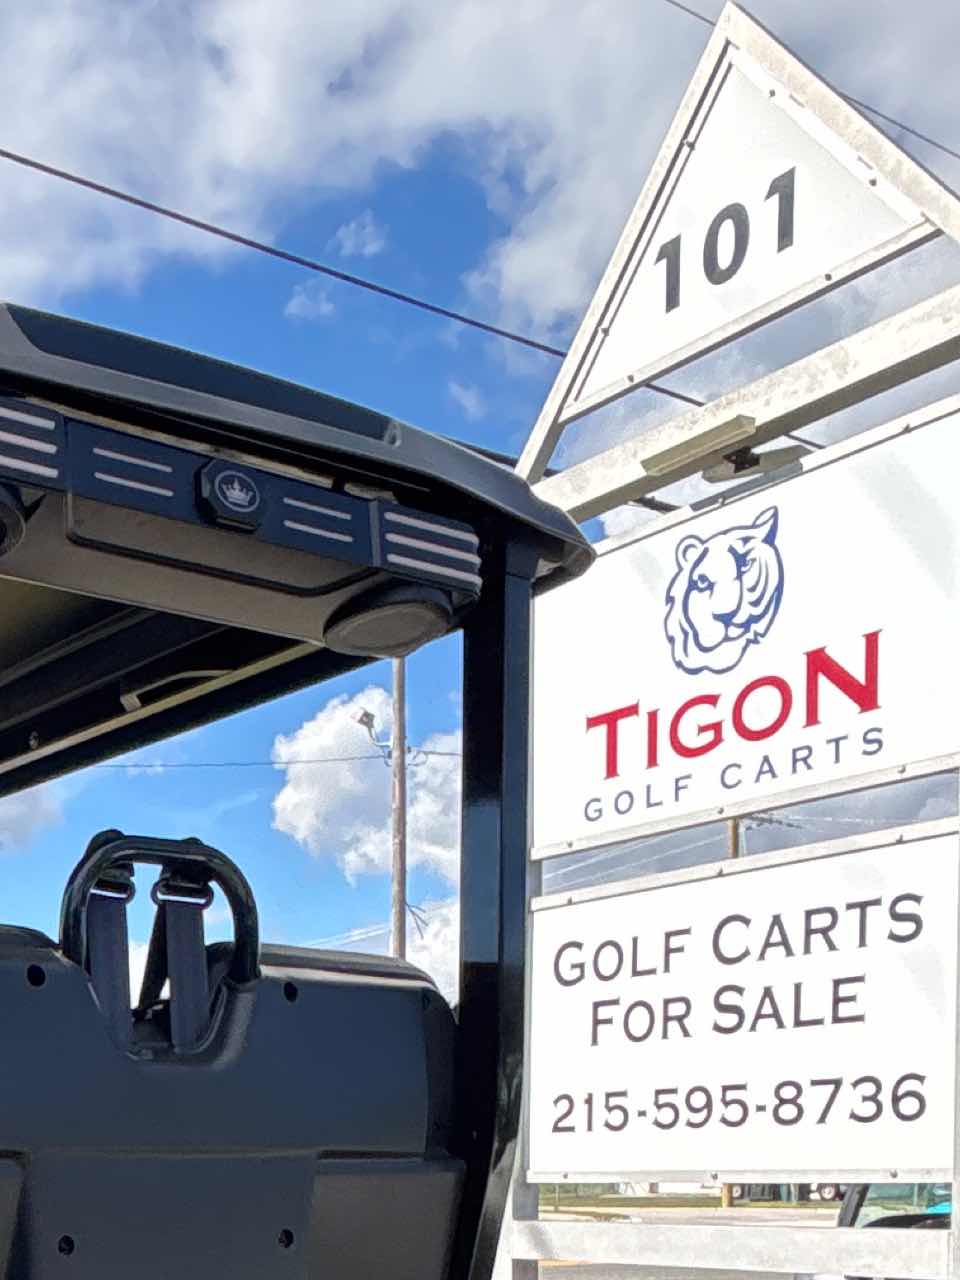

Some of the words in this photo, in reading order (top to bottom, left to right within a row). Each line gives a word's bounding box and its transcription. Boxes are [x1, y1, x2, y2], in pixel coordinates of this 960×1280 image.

[654, 166, 796, 314] 101
[585, 628, 883, 780] TIGON
[583, 774, 692, 822] GOLF
[720, 726, 884, 790] CARTS
[552, 926, 692, 987] GOLF
[712, 892, 925, 966] CARTS
[590, 996, 693, 1047] FOR
[712, 974, 867, 1036] SALE
[551, 1072, 928, 1133] 215-595-8736
